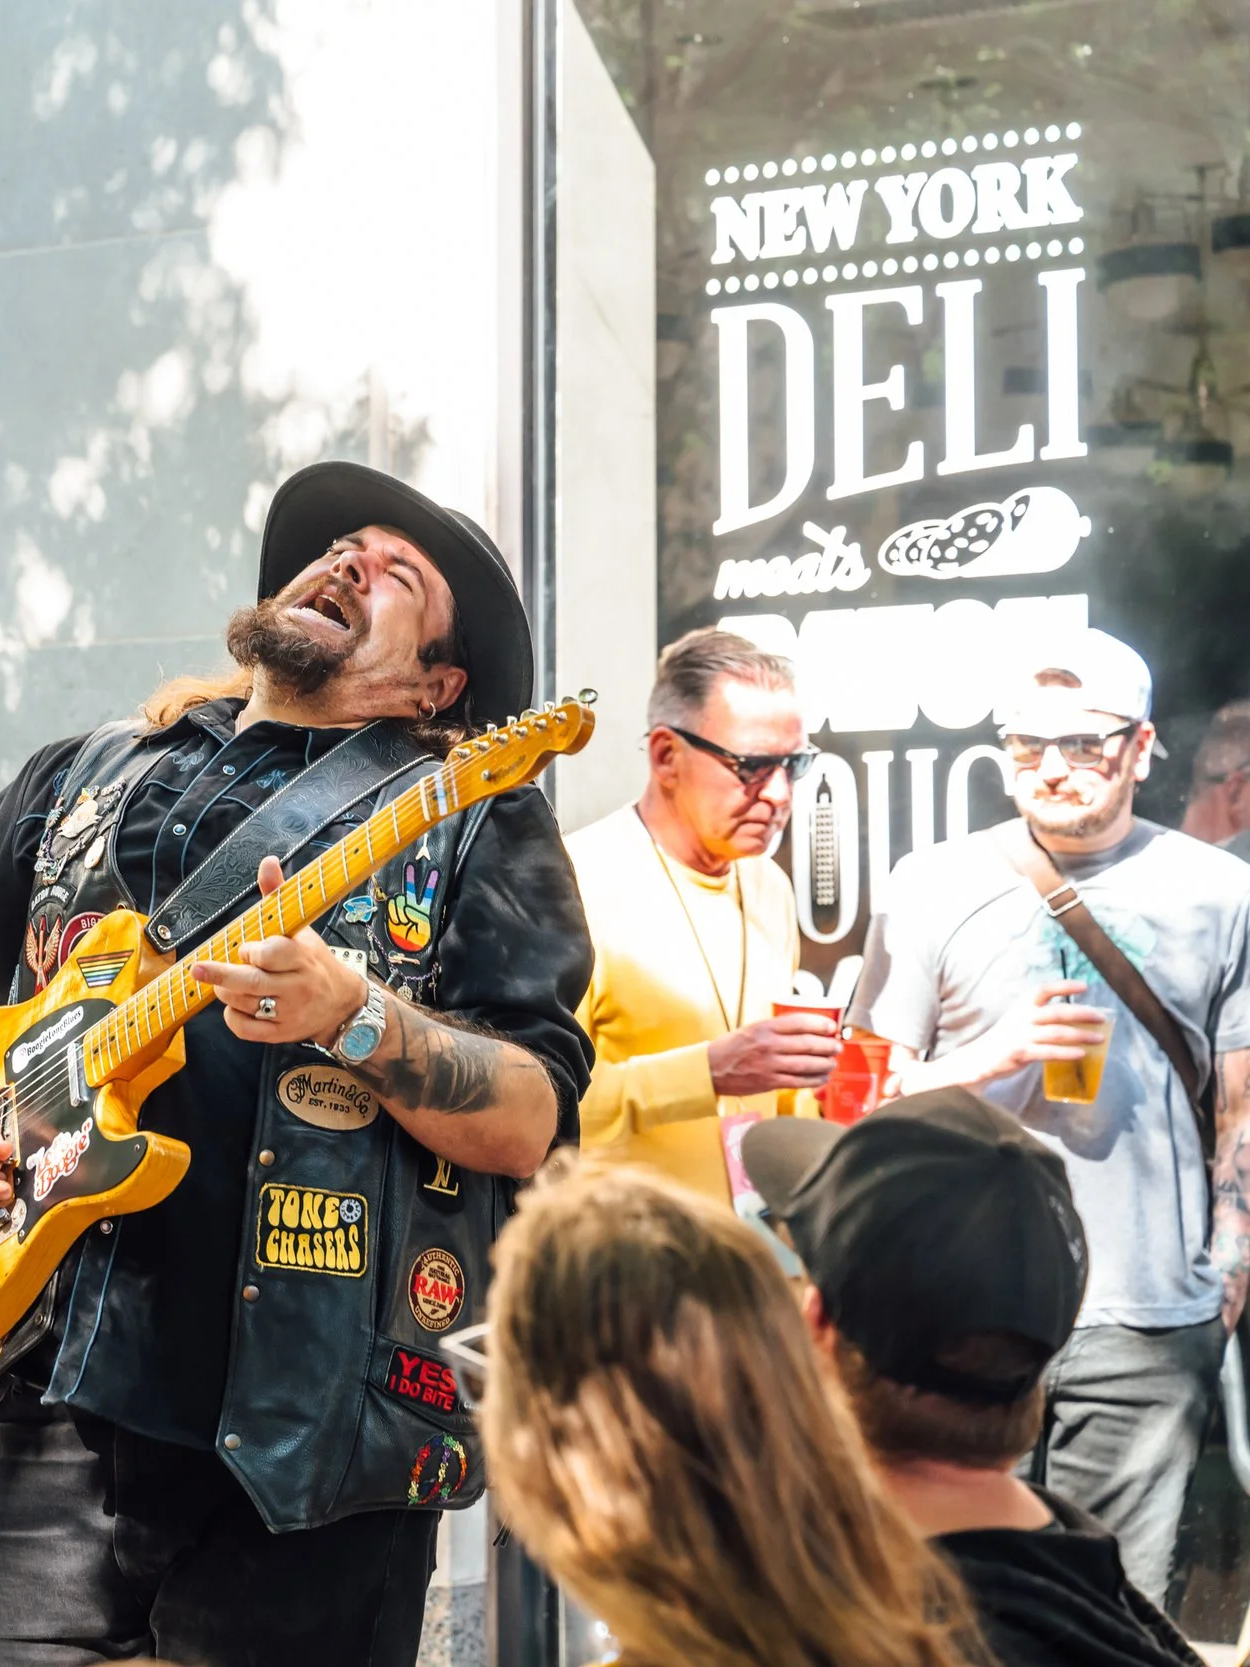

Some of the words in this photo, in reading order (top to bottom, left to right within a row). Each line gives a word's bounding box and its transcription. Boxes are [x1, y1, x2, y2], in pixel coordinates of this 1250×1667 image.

[711, 180, 868, 265] NEW
[875, 153, 1084, 245] YORK
[711, 267, 1088, 537] DELI
[713, 521, 871, 600] meats
[308, 1097, 327, 1109] EST.
[267, 1188, 340, 1230] TONE
[266, 1224, 360, 1271] CHASERS
[422, 1251, 460, 1277] AUTHENTIC
[414, 1274, 462, 1306] RAW
[414, 1304, 451, 1328] UNREFINED
[390, 1374, 397, 1391] I
[398, 1377, 421, 1398] DO
[422, 1385, 455, 1411] BITE
[398, 1351, 457, 1393] YES
